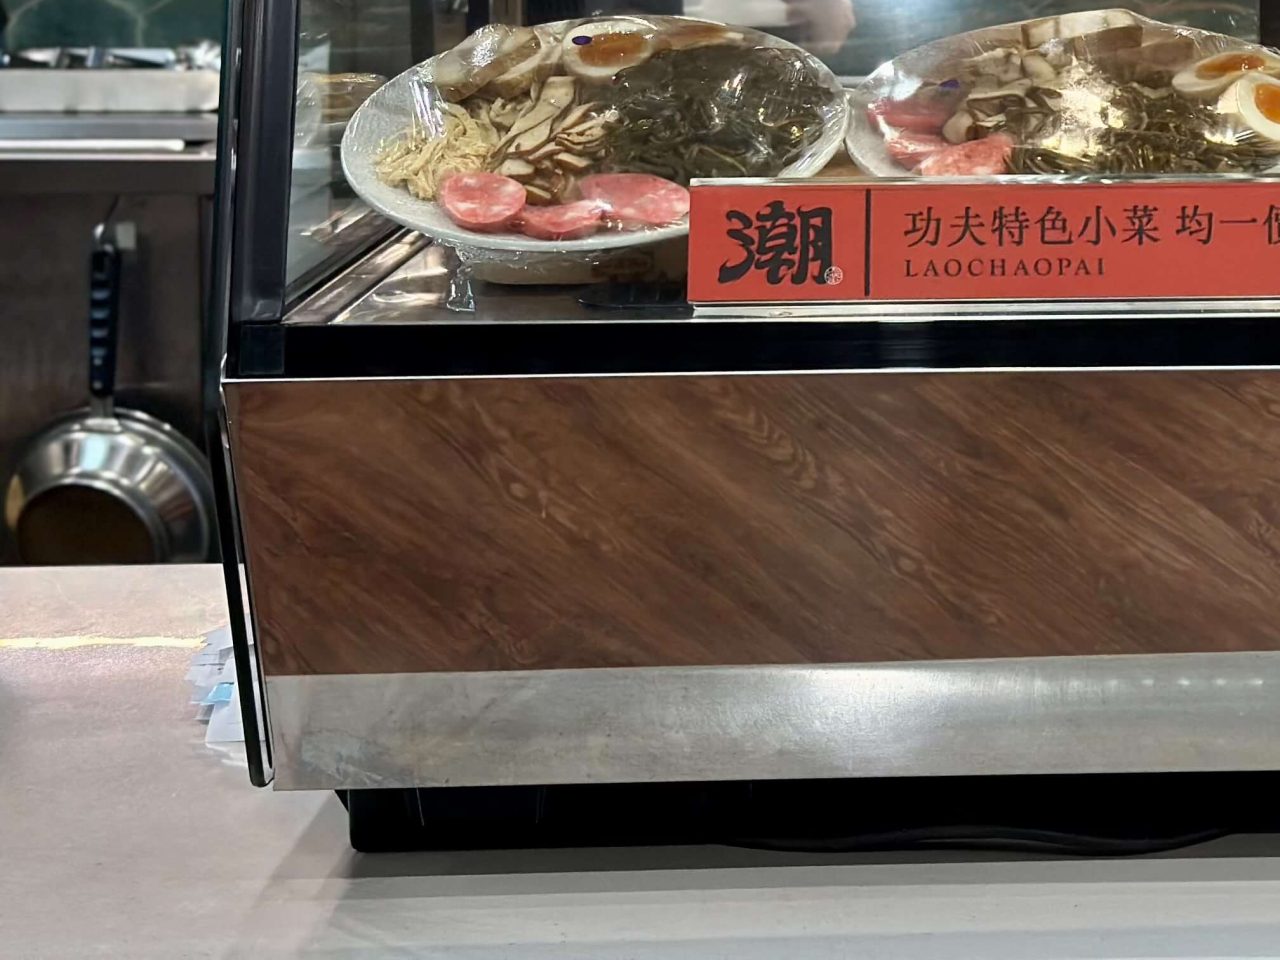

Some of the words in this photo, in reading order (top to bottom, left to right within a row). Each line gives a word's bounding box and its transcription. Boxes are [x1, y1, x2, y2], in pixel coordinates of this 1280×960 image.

[719, 200, 832, 286] 潮
[902, 205, 1160, 247] 功夫特色小菜
[904, 257, 1105, 278] LAOCHAOPAI
